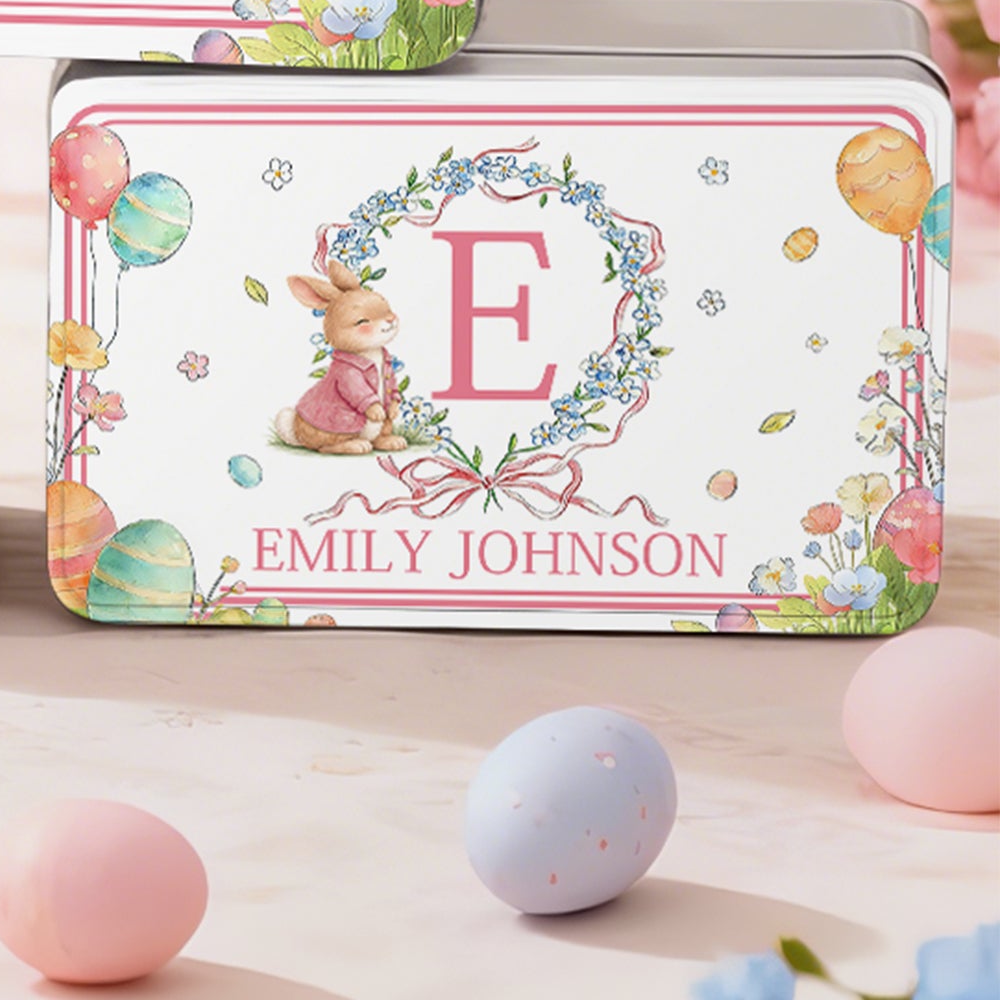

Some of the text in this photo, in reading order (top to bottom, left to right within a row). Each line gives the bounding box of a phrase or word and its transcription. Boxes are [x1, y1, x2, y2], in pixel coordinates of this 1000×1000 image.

[431, 230, 558, 401] E
[254, 528, 727, 580] EMILY JOHNSON
